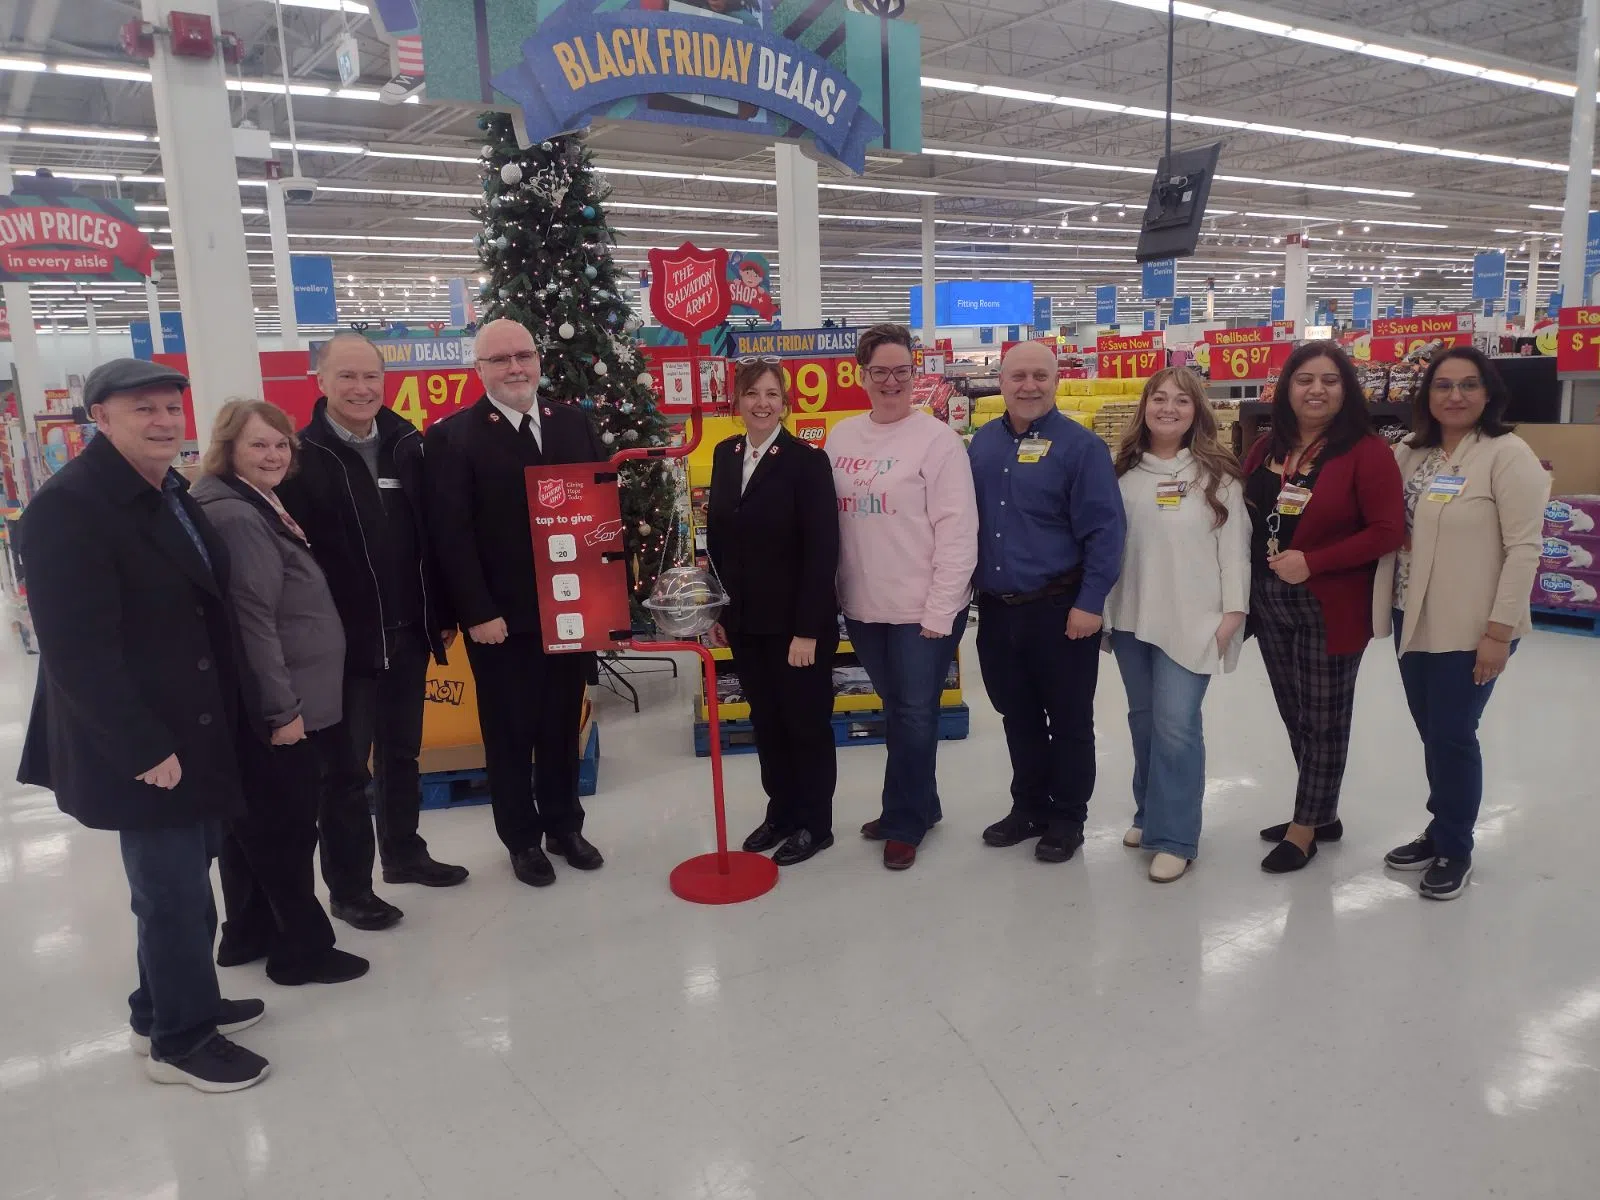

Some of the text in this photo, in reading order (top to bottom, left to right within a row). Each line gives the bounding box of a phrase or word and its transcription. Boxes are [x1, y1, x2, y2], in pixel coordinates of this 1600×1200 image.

[552, 28, 847, 125] BLACK FRIDAY DEALS!
[0, 210, 122, 249] OW PRICES
[8, 255, 108, 272] in every aisle
[672, 264, 695, 286] THE
[667, 268, 713, 309] SALVATION
[729, 283, 758, 304] SHOP
[685, 287, 713, 318] ARMY
[957, 299, 1000, 310] Fitting Rooms
[1390, 319, 1452, 334] Save Now
[738, 332, 856, 353] BLACK FRIDAY DEALS!
[1108, 339, 1150, 351] Save Now
[1216, 331, 1261, 344] Rollback
[415, 342, 461, 361] DEALS!
[799, 427, 825, 440] LEGO
[834, 456, 900, 475] merry
[535, 513, 593, 526] tap to give
[1543, 581, 1571, 590] Royale
